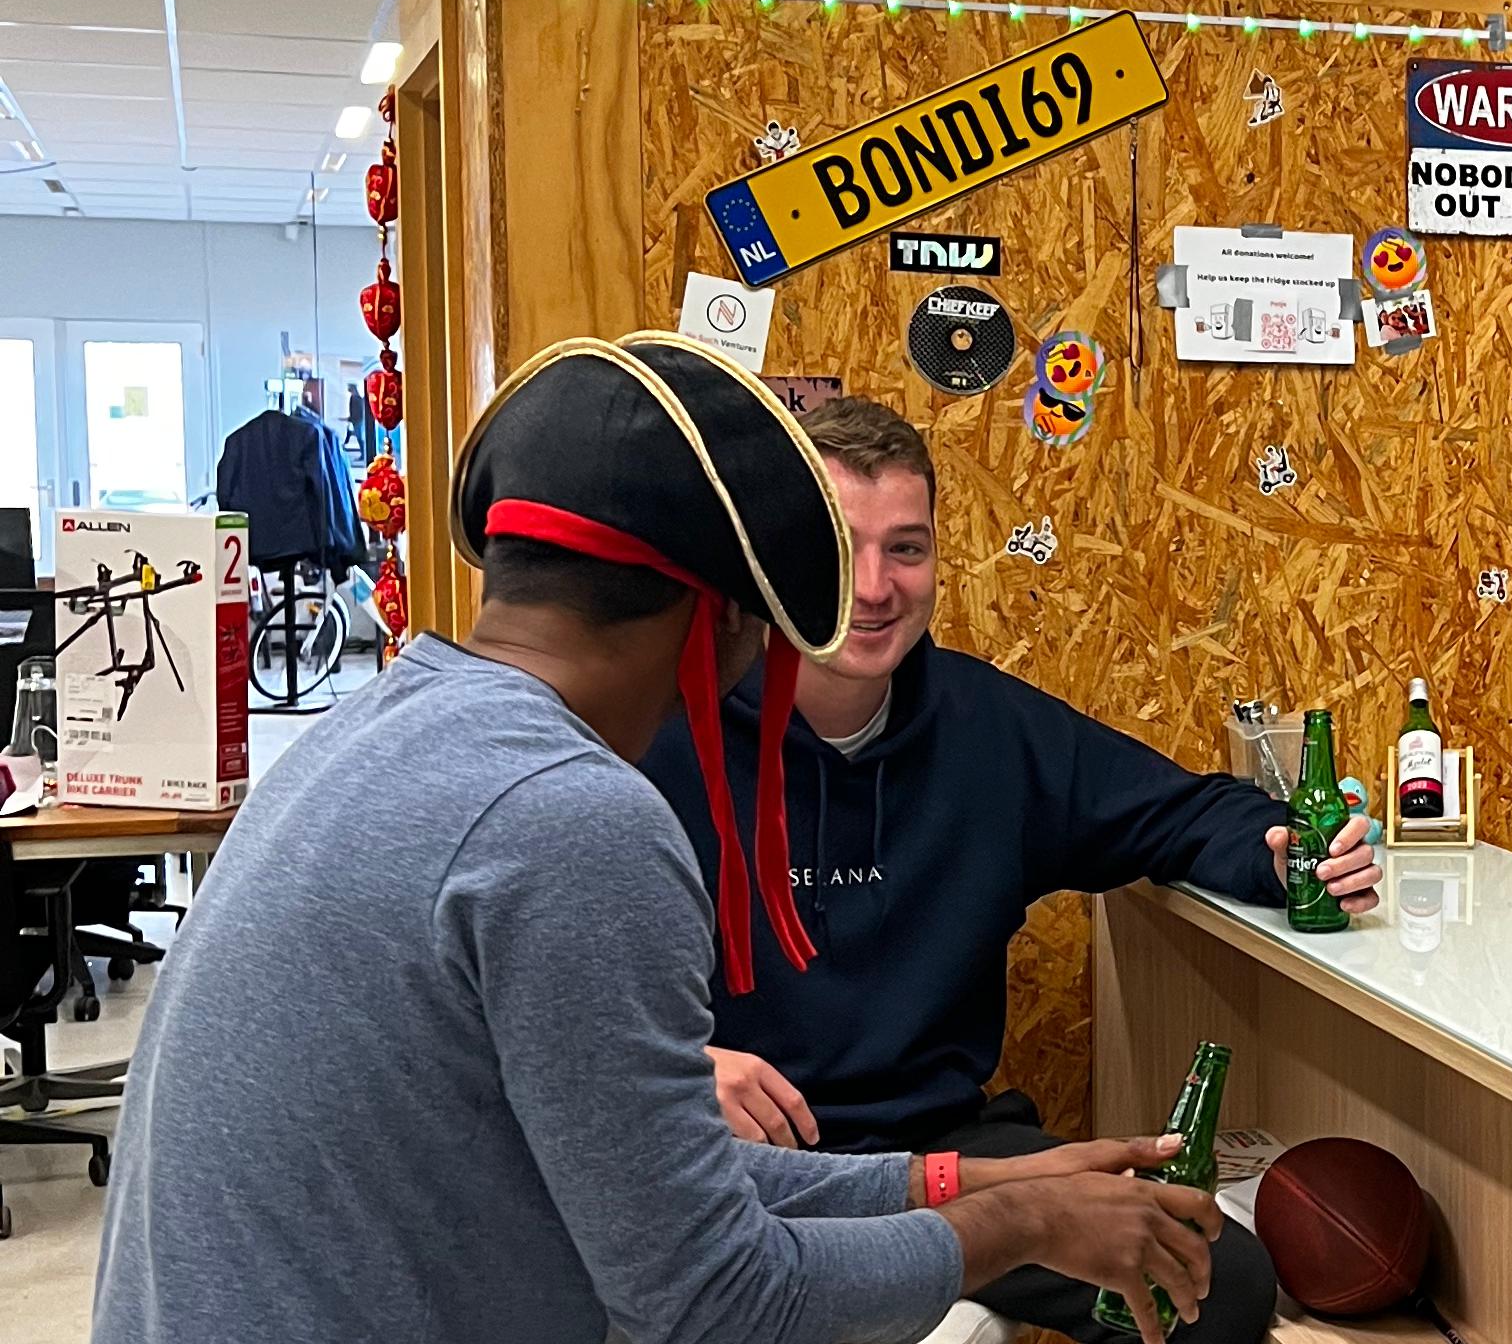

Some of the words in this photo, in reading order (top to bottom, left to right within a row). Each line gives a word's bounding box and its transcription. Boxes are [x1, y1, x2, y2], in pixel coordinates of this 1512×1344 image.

[1435, 193, 1500, 218] OUT
[739, 240, 777, 268] NL
[76, 521, 131, 533] ALLEN
[223, 535, 242, 584] 2
[66, 772, 106, 783] DELUXE
[109, 774, 143, 786] TRUNK
